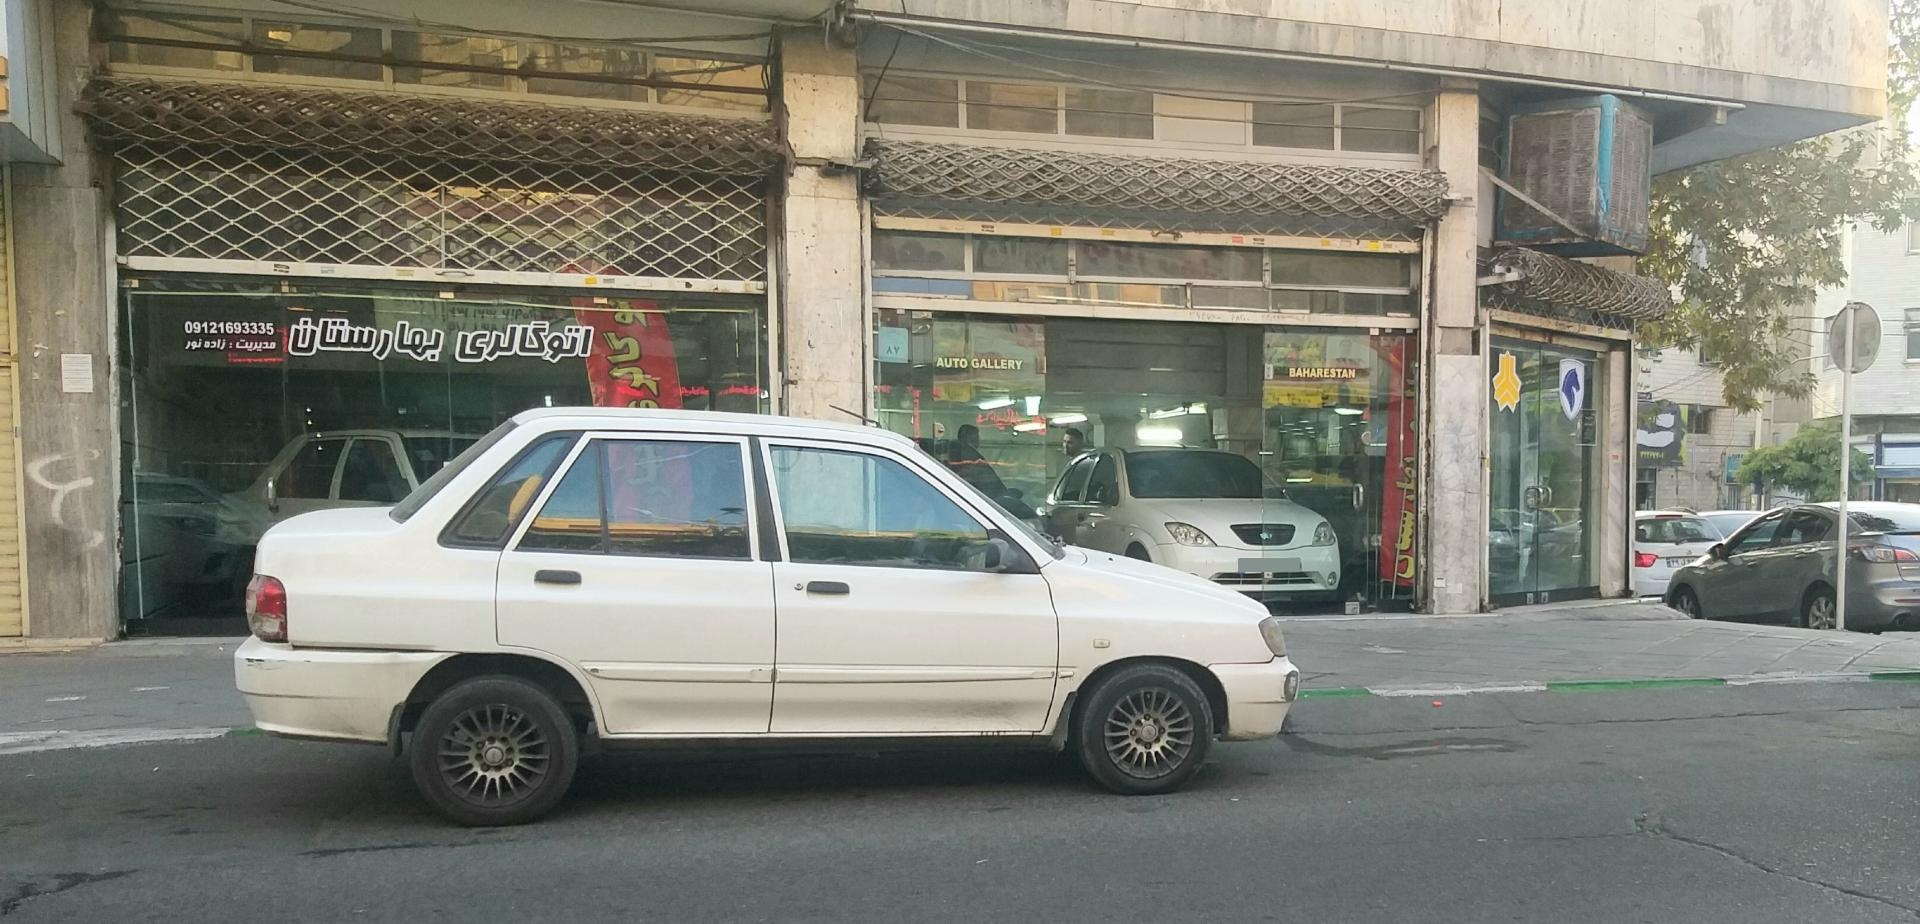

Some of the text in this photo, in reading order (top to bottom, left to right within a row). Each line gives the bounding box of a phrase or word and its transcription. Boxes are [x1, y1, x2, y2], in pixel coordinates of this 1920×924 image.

[184, 320, 275, 336] 09121693335
[184, 338, 202, 350] نور
[203, 339, 226, 350] زاده
[235, 339, 277, 352] مدیریت
[936, 357, 1023, 371] AUTO GALLERY
[1289, 367, 1356, 379] BAHARESTAN
